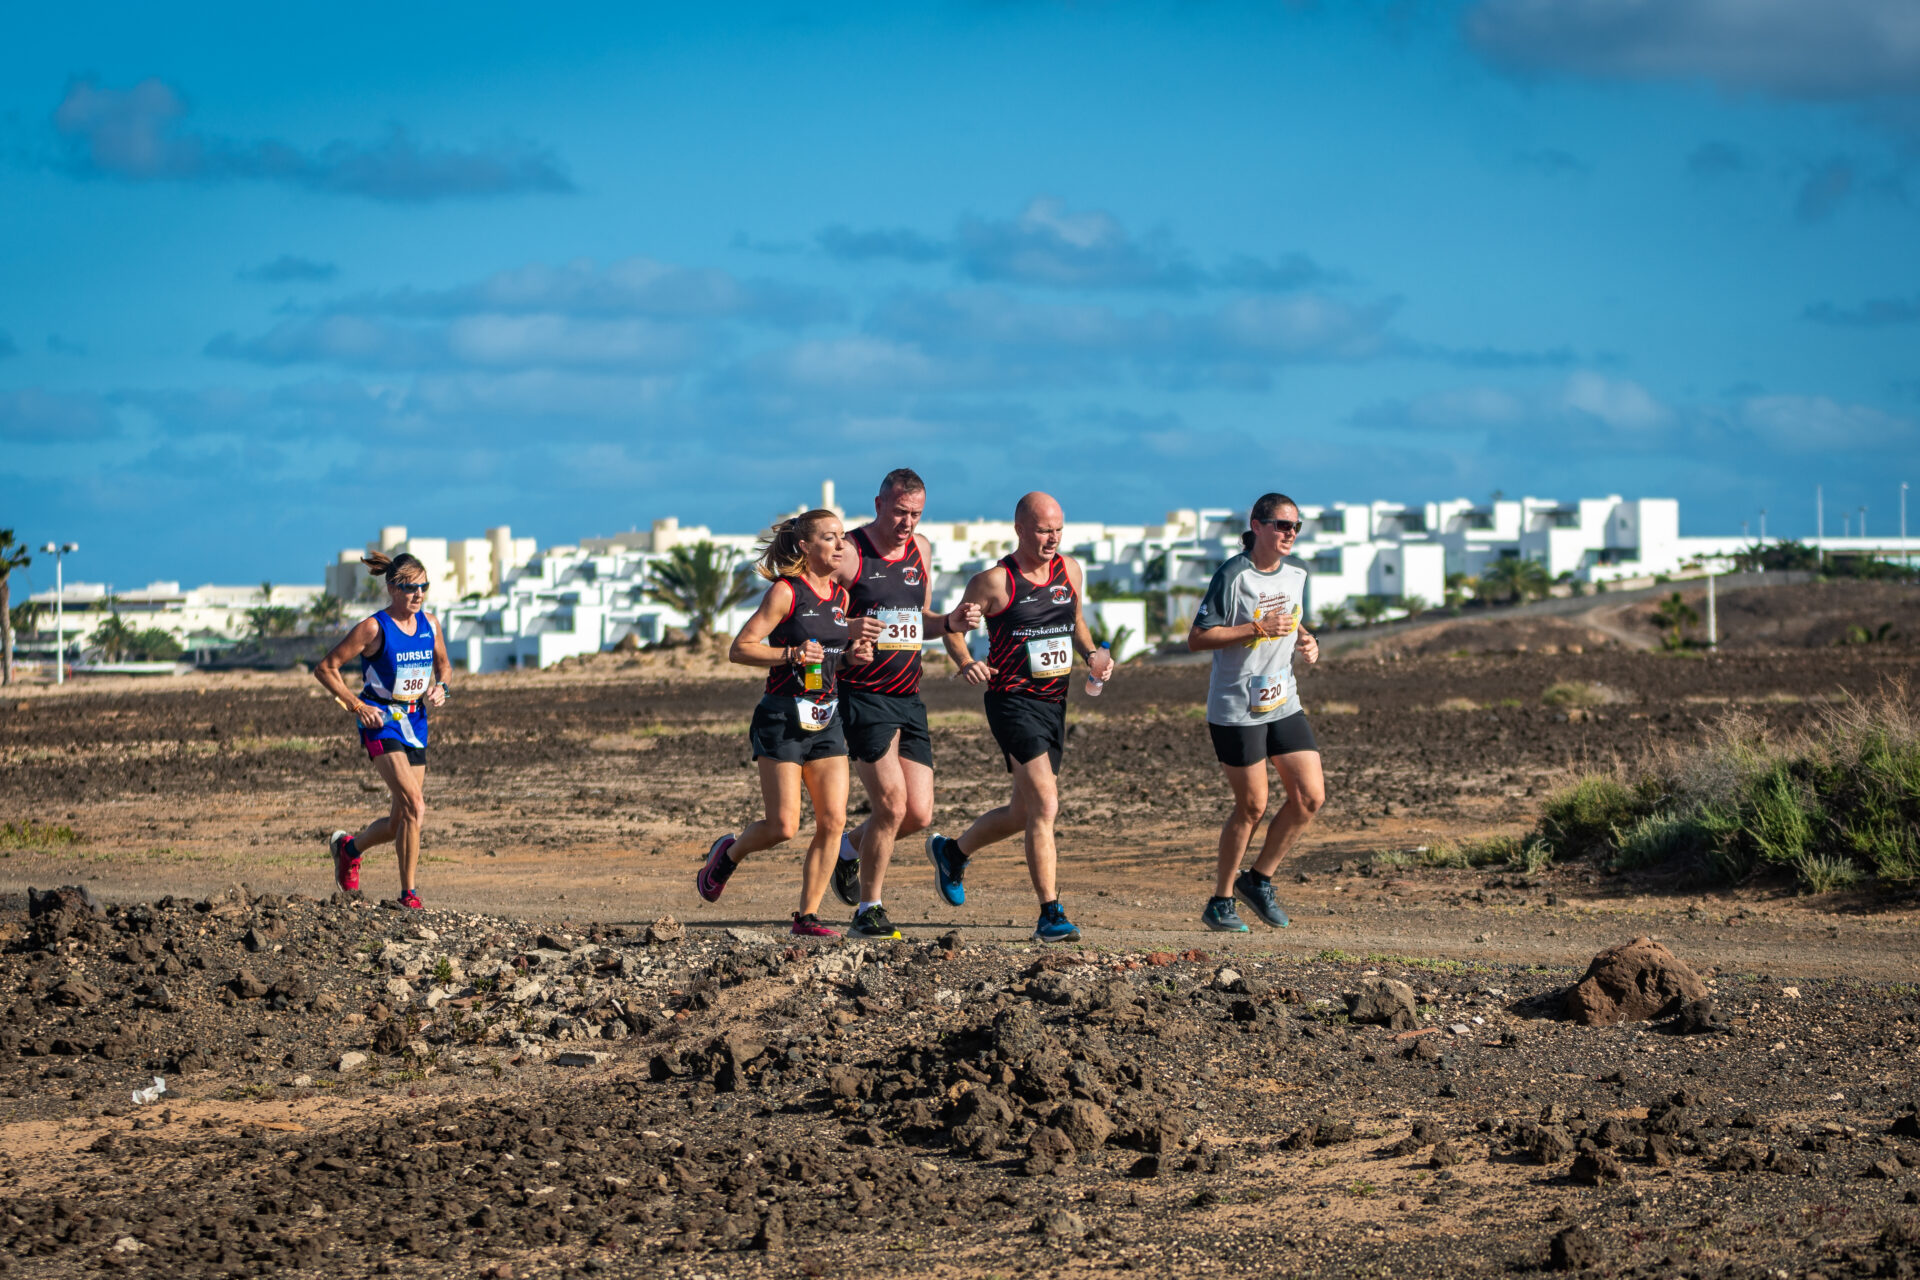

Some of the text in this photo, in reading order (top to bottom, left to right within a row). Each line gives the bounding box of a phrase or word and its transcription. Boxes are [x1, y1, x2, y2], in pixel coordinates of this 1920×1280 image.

[888, 624, 917, 639] 318
[1040, 650, 1067, 666] 370
[402, 679, 424, 690] 386
[1259, 683, 1282, 702] 220
[811, 706, 830, 721] 82
